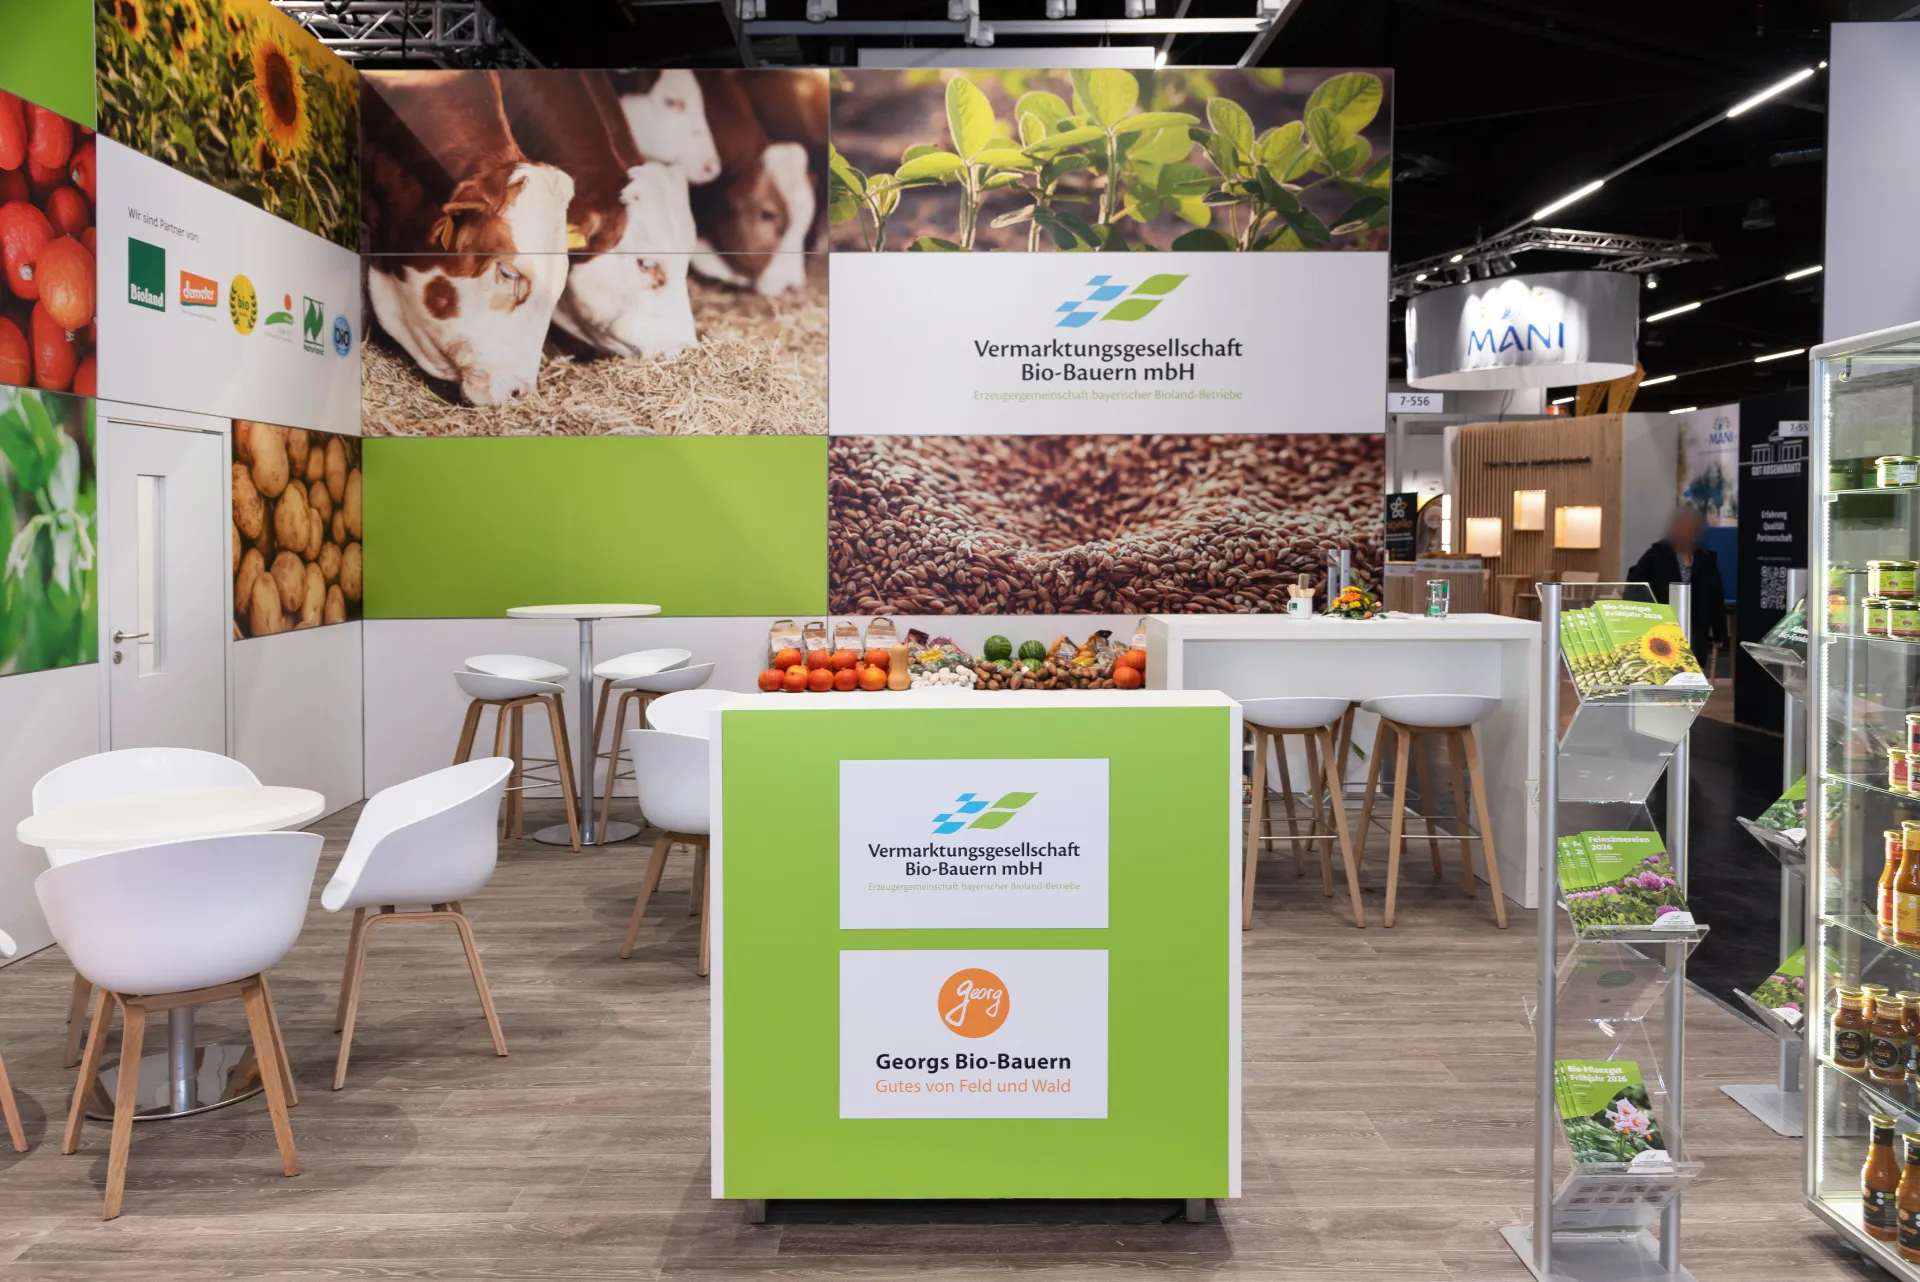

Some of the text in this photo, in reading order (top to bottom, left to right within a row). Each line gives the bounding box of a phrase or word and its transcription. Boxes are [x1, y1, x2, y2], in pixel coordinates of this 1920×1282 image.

[128, 206, 200, 243] Wir sind Partner von:
[130, 283, 164, 307] Bioland
[183, 280, 214, 301] demeter
[1467, 322, 1564, 356] MANI
[974, 338, 1243, 363] Vermarktungsgesellschaft
[1021, 361, 1195, 381] Bio-Bauern mbH
[974, 389, 1243, 403] Erzeugergemeinschaft bayerischer Bioland-Betriebe
[1400, 396, 1430, 406] 7-556
[1790, 423, 1809, 432] 7-55
[1710, 431, 1734, 445] MANI
[1761, 510, 1788, 520] Erfahrung
[1763, 522, 1785, 531] Qualität
[1756, 533, 1793, 542] Partnerschaft
[1587, 836, 1651, 844] Feinsämereien
[868, 842, 1081, 861] Vermarktungsgesellschaft
[905, 861, 1043, 876] Bio-Bauern mbH
[868, 882, 1081, 893] Erzeugergemeinschaft bayerischer Bioland-Betriebe
[945, 979, 1003, 1027] georg
[876, 1053, 1072, 1074] Georgs Bio-Bauern
[1567, 1065, 1623, 1075] Bio-Pflanzgut
[1570, 1074, 1605, 1083] Frühjahr
[876, 1079, 1072, 1093] Gutes von Feld und Wald
